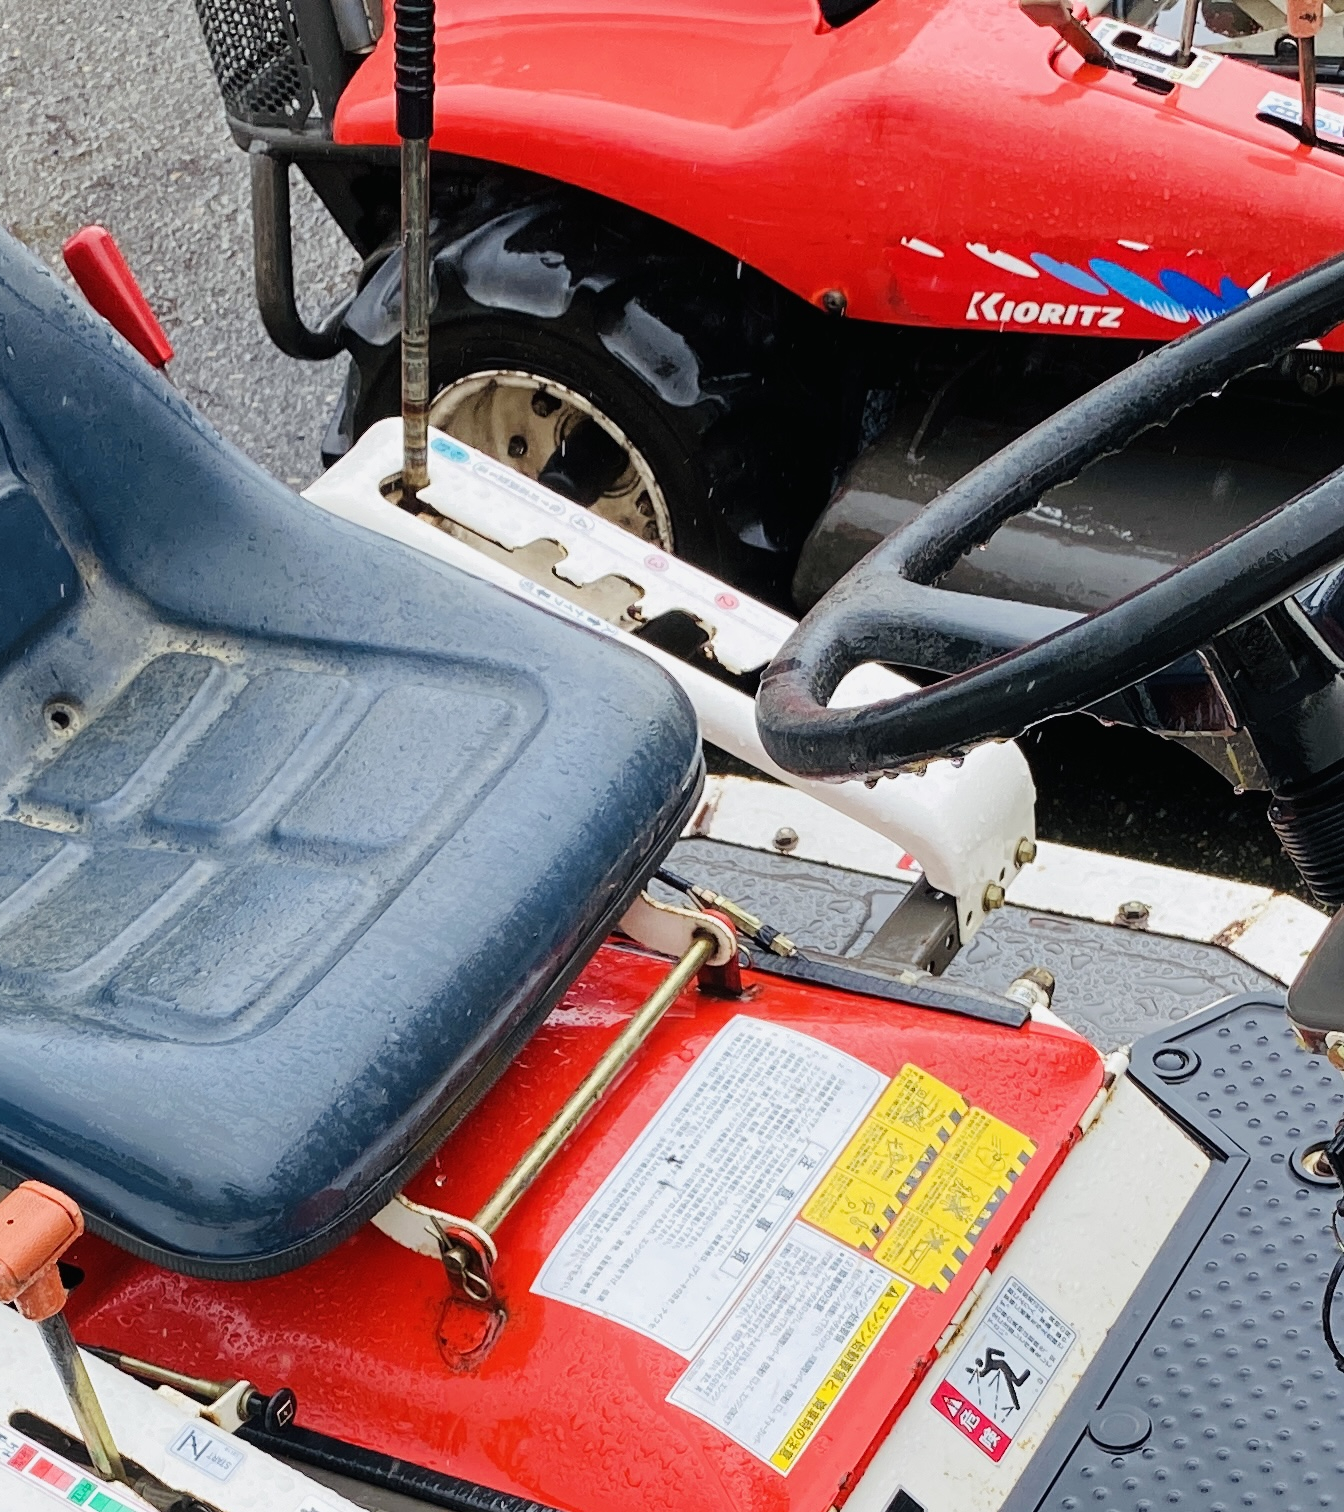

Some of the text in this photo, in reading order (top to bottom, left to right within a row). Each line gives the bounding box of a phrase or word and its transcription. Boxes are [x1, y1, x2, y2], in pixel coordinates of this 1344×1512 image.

[966, 292, 1125, 329] KIORITZ
[727, 1153, 818, 1265] 注意事項
[777, 1300, 891, 1462] エンジン始動要領と、降車時の注意
[956, 1405, 1002, 1453] 危険
[205, 1451, 232, 1470] START
